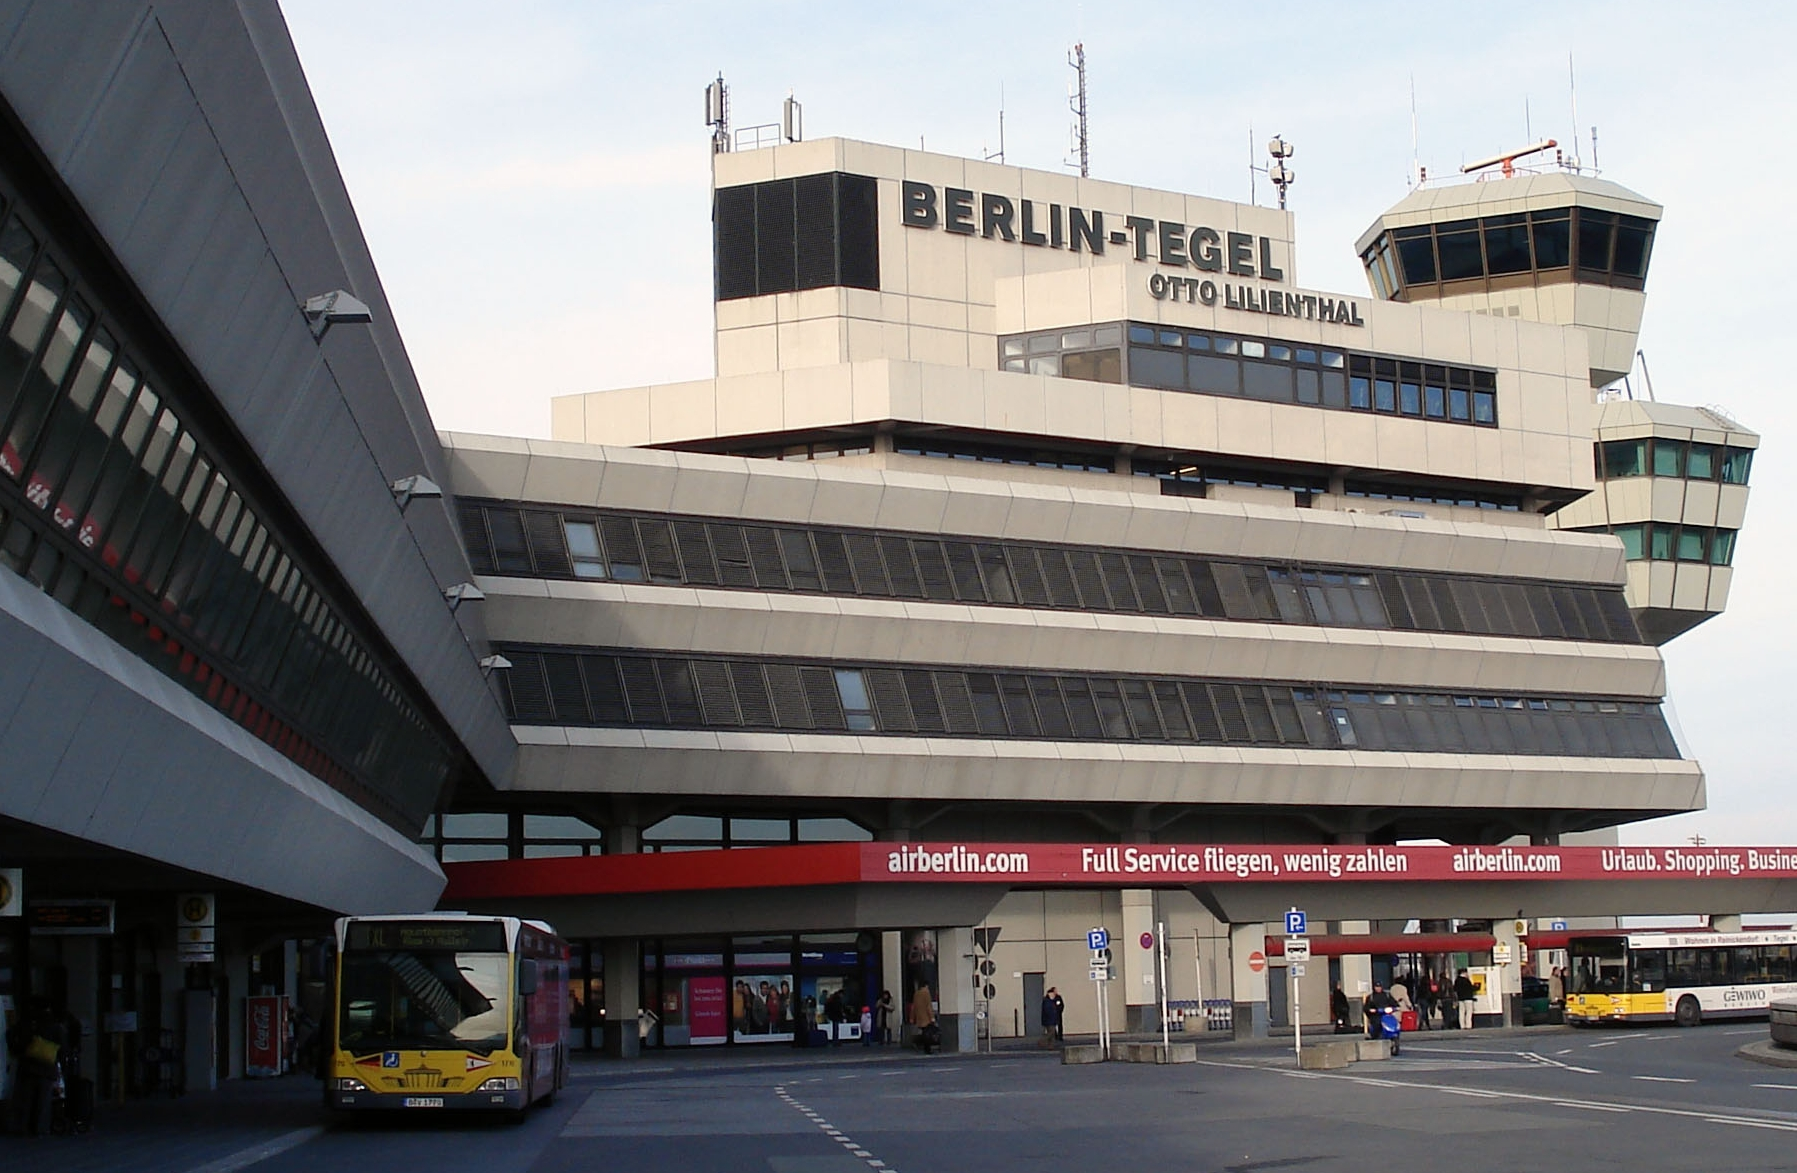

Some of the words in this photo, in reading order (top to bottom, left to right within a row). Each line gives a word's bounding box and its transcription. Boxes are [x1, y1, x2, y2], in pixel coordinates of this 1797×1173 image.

[900, 179, 1284, 281] BERLIN-TEGEL
[1148, 272, 1218, 306] OTTO
[1222, 283, 1365, 326] LILIENTHAL
[888, 845, 1029, 874] airberlin.com
[1082, 846, 1121, 873] Full
[1124, 847, 1200, 874] Service
[1204, 847, 1280, 878] fliegen,
[1284, 848, 1342, 878] wenig
[1345, 848, 1408, 874] zahlen
[1452, 847, 1562, 873] airberlin.com
[1602, 849, 1662, 872] Urlaub.
[1665, 850, 1745, 876] Shopping.
[1290, 914, 1302, 932] P
[1723, 987, 1766, 1002] GEWIWO
